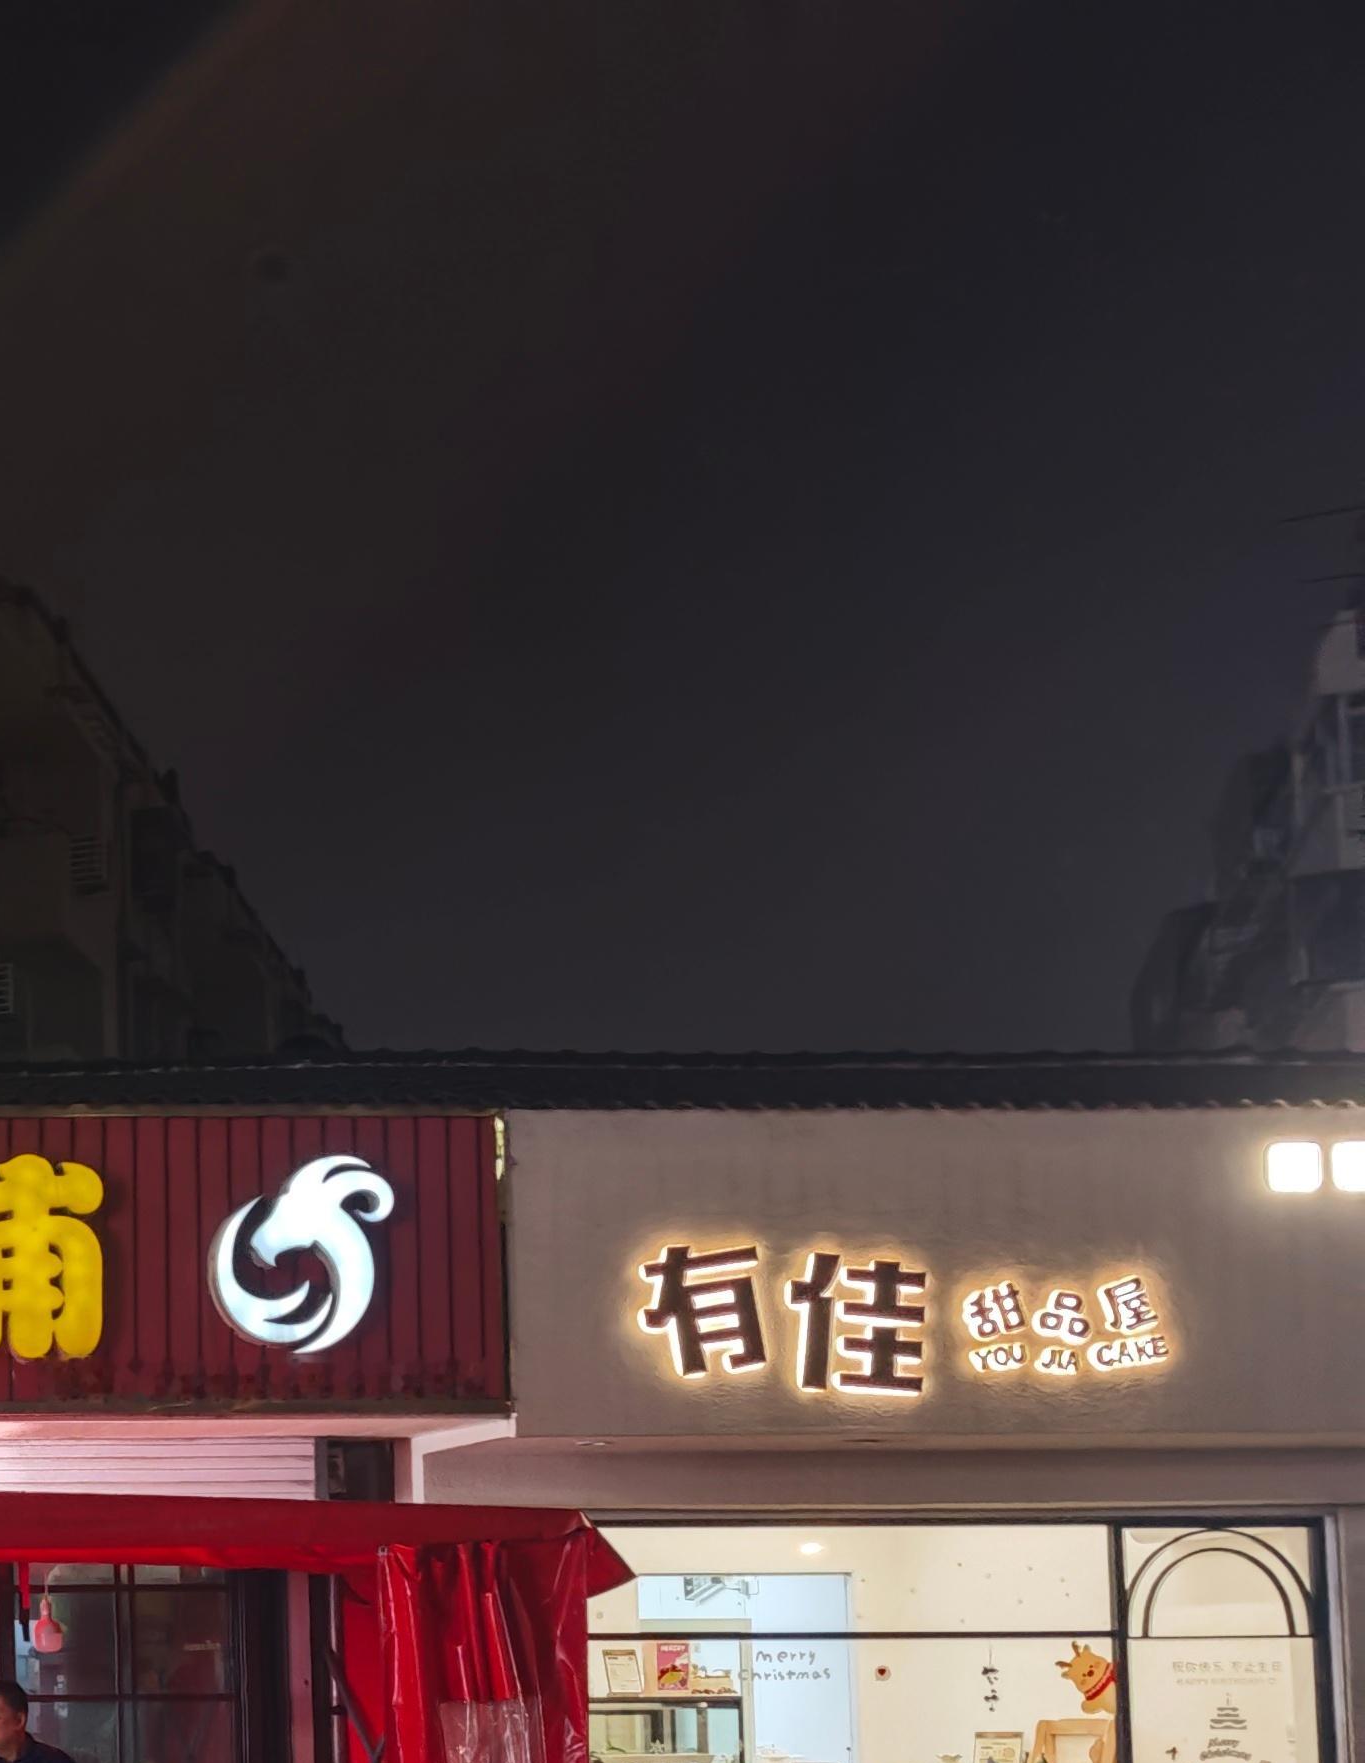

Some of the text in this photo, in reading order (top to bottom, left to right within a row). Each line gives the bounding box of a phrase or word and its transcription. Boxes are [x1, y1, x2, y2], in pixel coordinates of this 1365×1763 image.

[642, 1244, 928, 1397] 有佳
[968, 1277, 1159, 1339] 甜品屋
[973, 1335, 1169, 1372] YOU JIA CAKE
